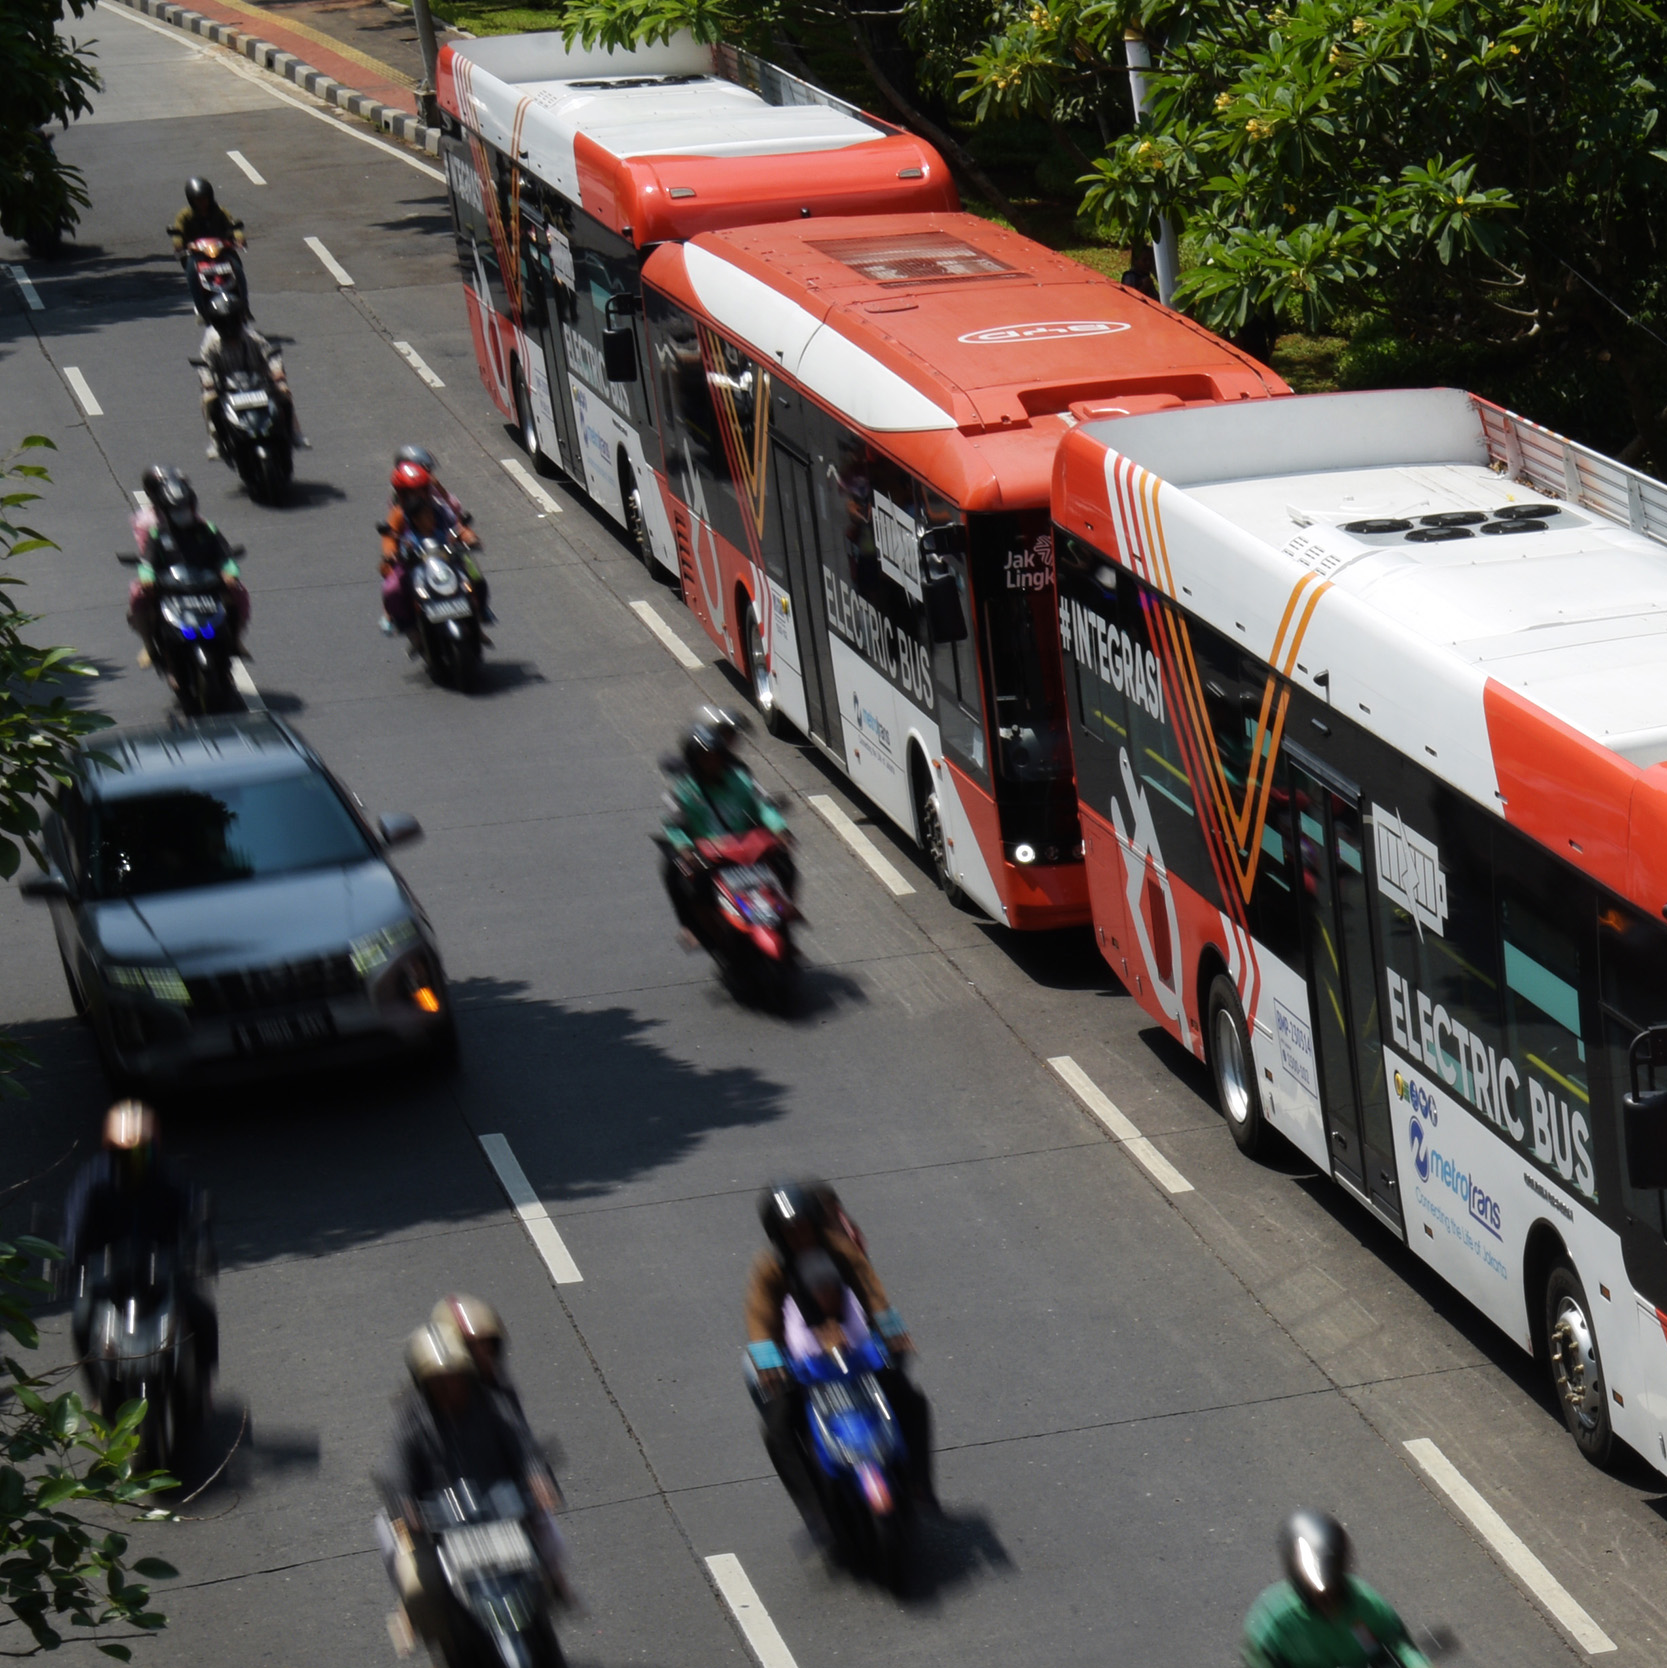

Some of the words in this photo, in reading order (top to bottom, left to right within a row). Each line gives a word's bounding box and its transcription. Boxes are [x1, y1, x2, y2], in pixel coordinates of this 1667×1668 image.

[1004, 550, 1036, 570] Jak
[1006, 567, 1055, 591] Lingk
[822, 563, 898, 680] ELECTRIC
[896, 626, 934, 711] BUS
[1058, 595, 1166, 724] #INTEGRASI
[1386, 966, 1525, 1142] ELECTRIC
[1528, 1076, 1595, 1198] BUS
[1430, 1149, 1503, 1243] metrotrans
